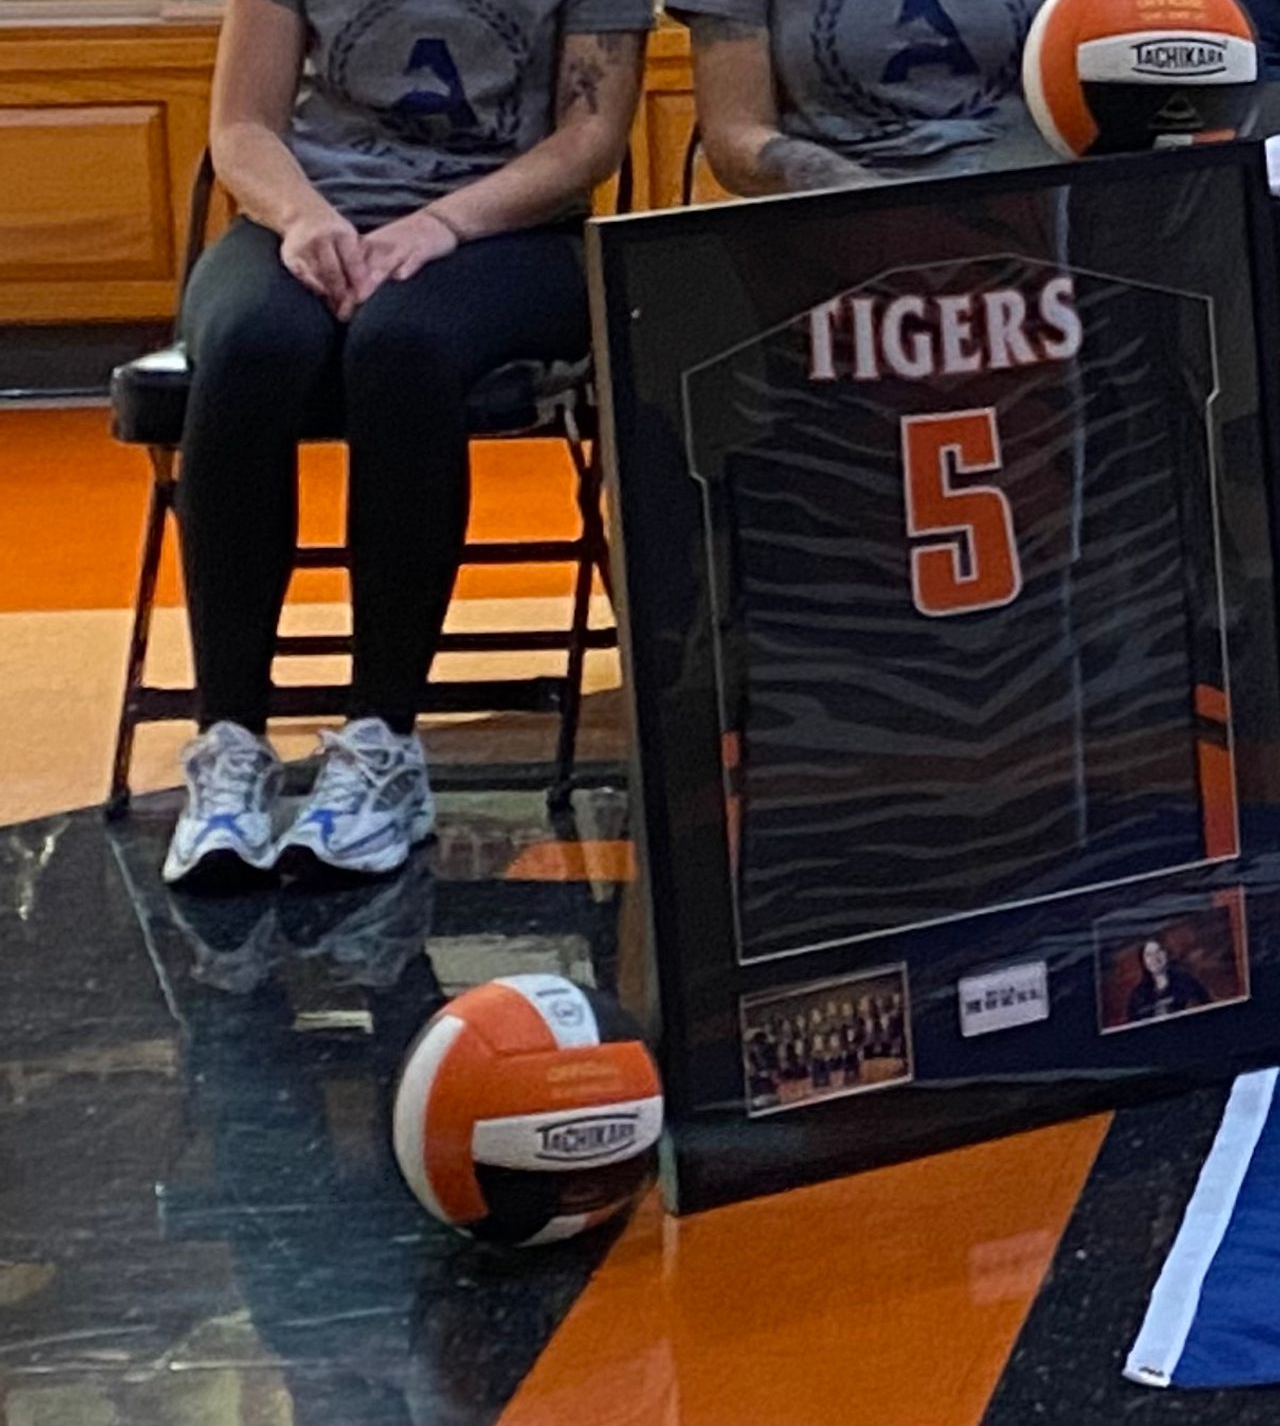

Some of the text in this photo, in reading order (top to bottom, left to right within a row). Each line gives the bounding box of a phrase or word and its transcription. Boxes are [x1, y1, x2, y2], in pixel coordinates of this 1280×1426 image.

[1130, 41, 1227, 72] TACHIKARA
[808, 276, 1084, 382] TIGERS
[900, 406, 1024, 618] 5
